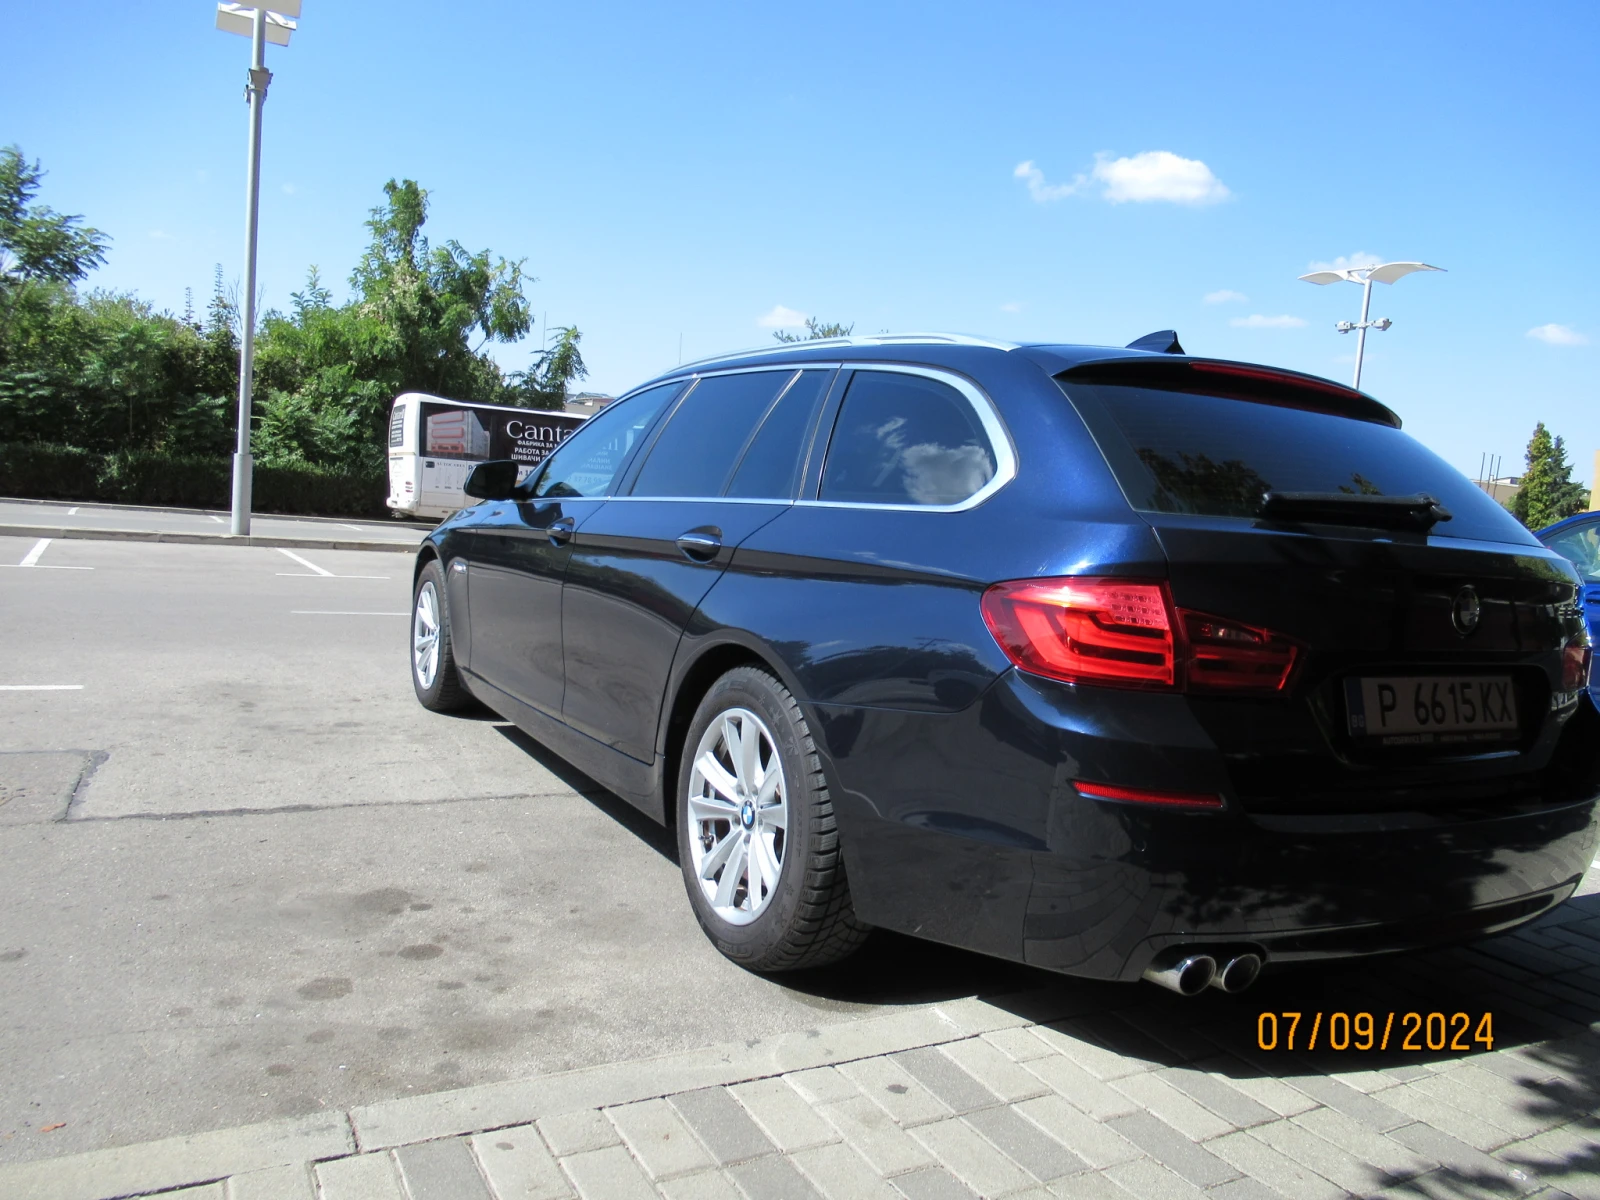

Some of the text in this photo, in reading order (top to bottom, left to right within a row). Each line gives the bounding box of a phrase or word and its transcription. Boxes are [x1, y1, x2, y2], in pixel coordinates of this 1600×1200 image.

[517, 440, 545, 448] ФАБРИКА
[514, 447, 540, 455] РАБОТА
[511, 453, 541, 462] ШИВАЧИ
[1377, 683, 1396, 727] P
